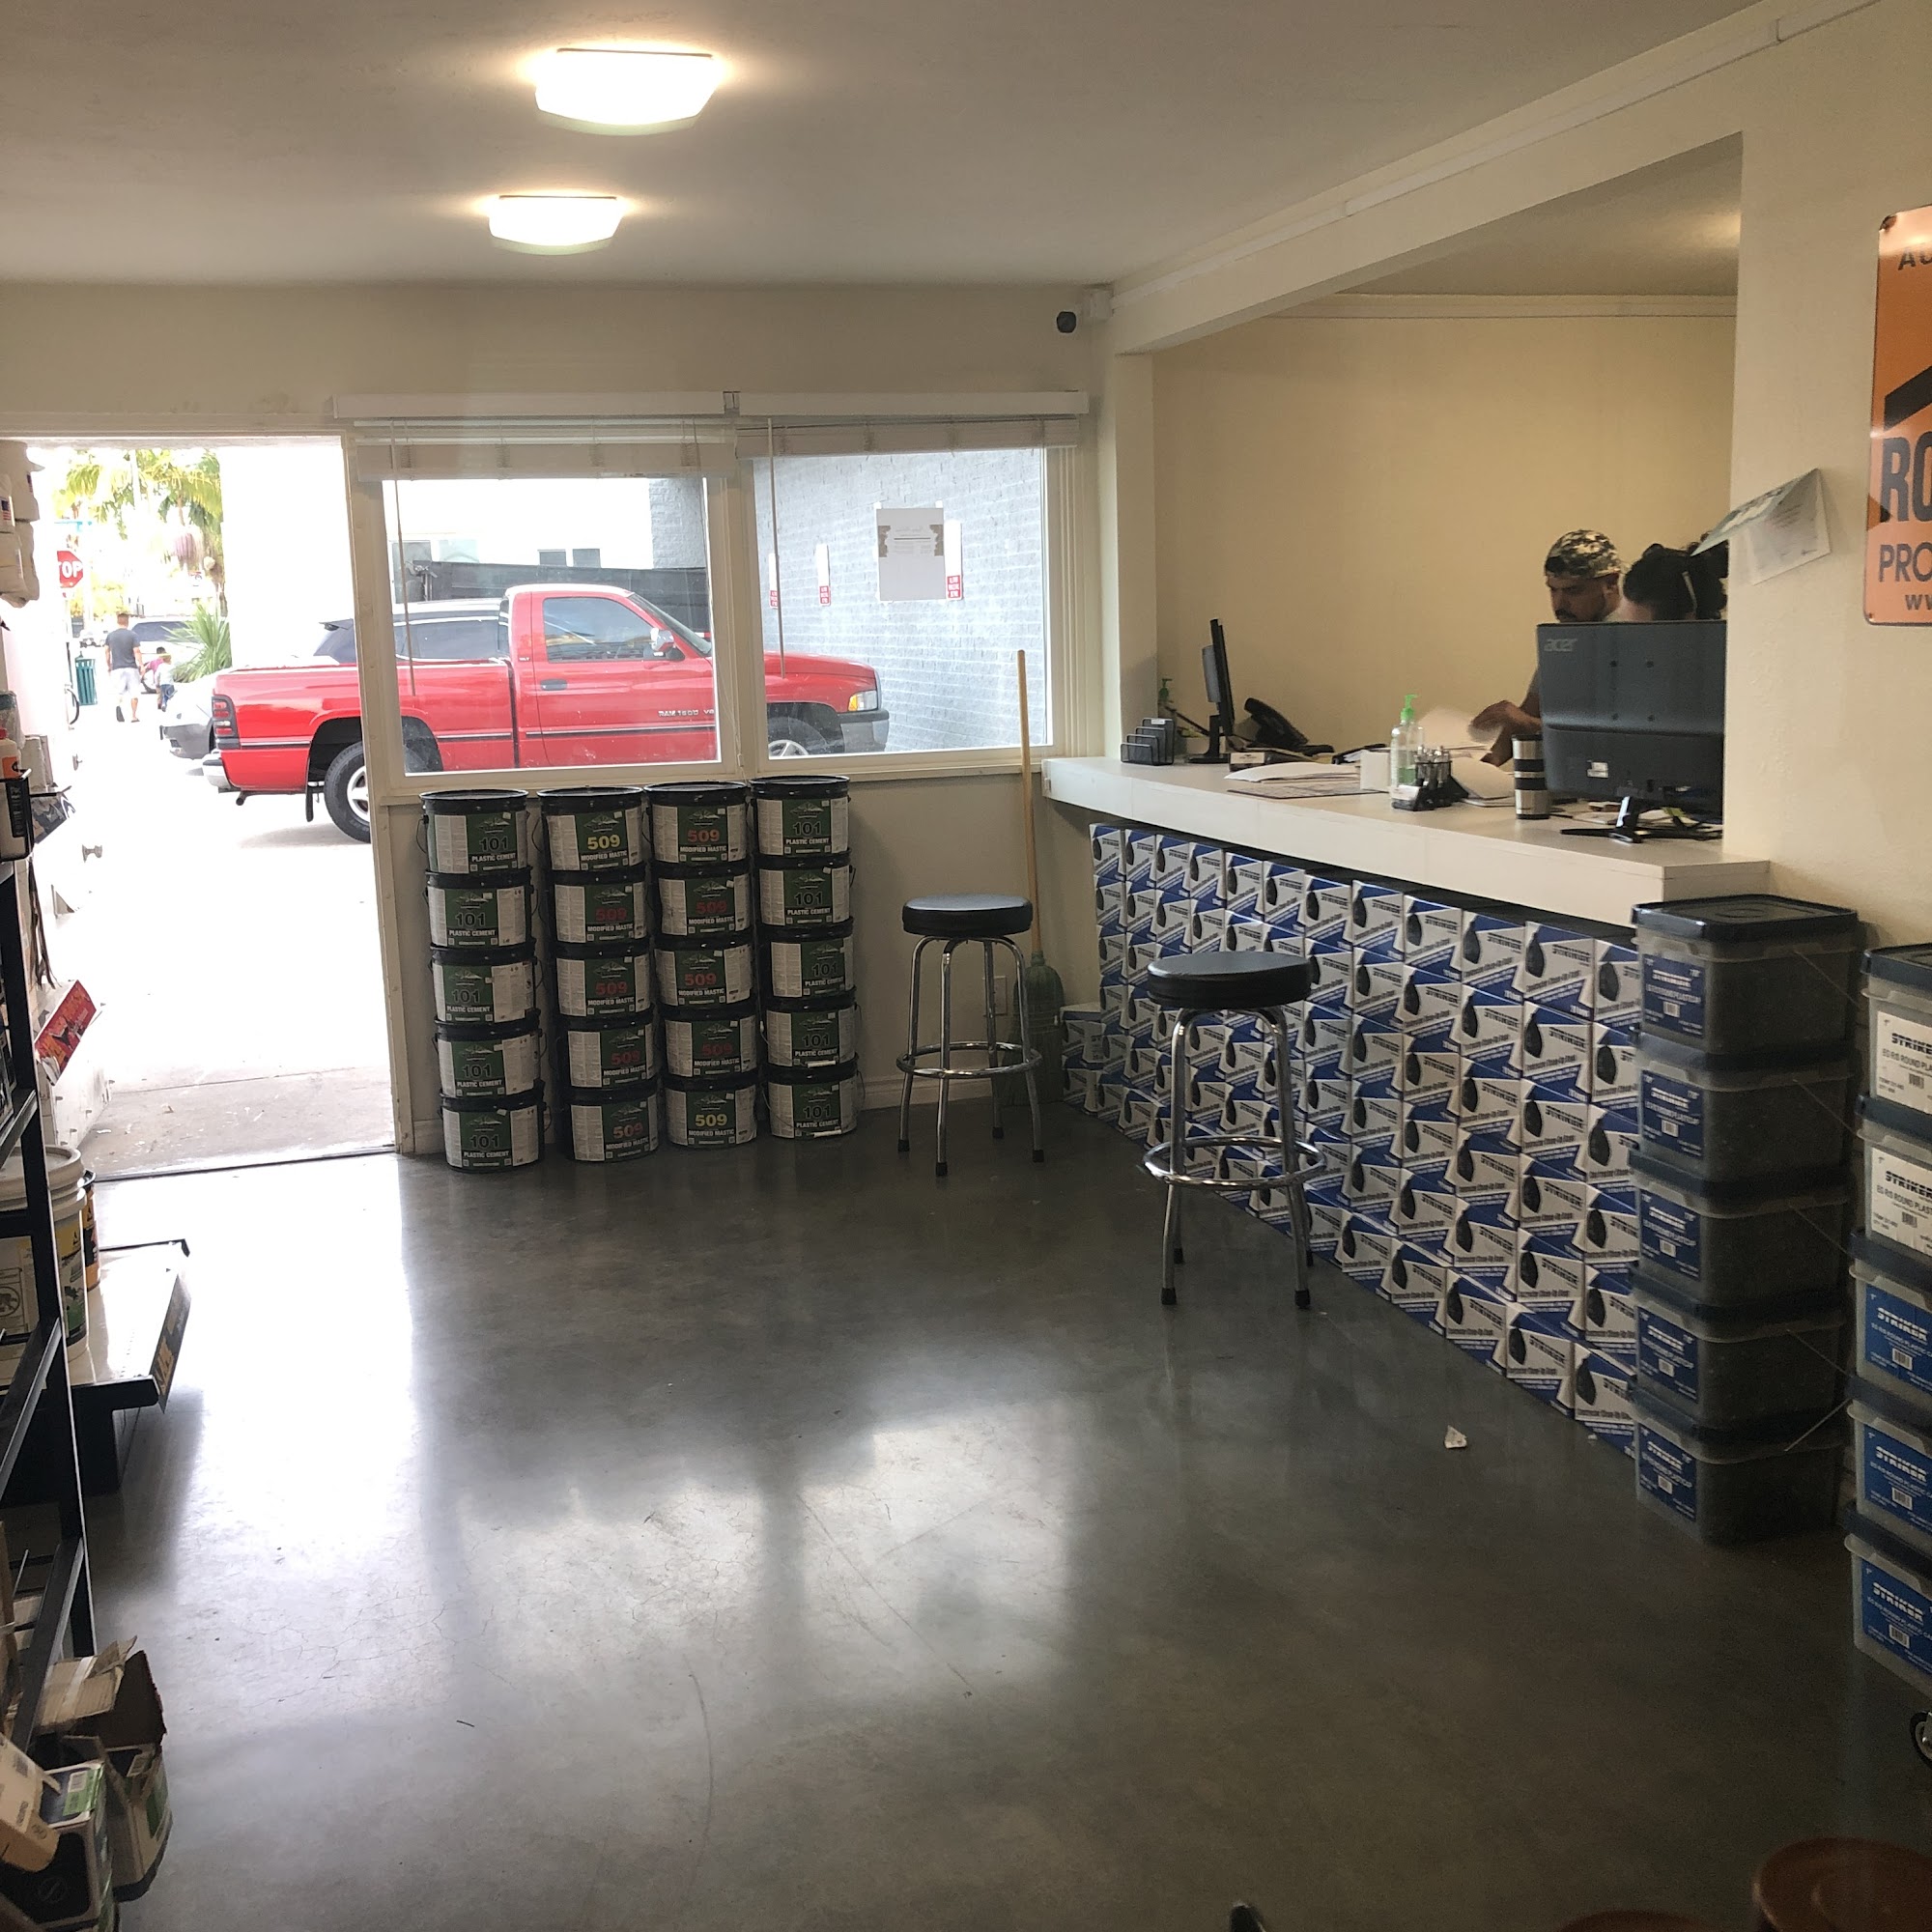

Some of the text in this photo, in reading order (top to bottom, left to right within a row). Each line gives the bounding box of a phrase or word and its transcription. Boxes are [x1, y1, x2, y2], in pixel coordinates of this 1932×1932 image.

[1880, 431, 1932, 523] RO
[1879, 542, 1932, 582] PRO
[1544, 639, 1577, 652] acer
[688, 829, 720, 842] 509
[793, 822, 822, 836] 101
[479, 837, 509, 851] 101
[587, 835, 620, 850] 509
[794, 893, 823, 905] 101
[456, 912, 485, 926] 101
[685, 973, 716, 986] 509
[452, 988, 480, 1003] 101
[803, 1034, 831, 1047] 101
[463, 1064, 491, 1078] 101
[804, 1105, 831, 1120] 101
[696, 1114, 727, 1126] 509
[470, 1134, 498, 1149] 101
[1886, 1170, 1932, 1200] STRIKER
[1877, 1307, 1928, 1342] STRIKER
[1875, 1445, 1927, 1483] STRIKER
[1873, 1581, 1923, 1623] STRIKER
